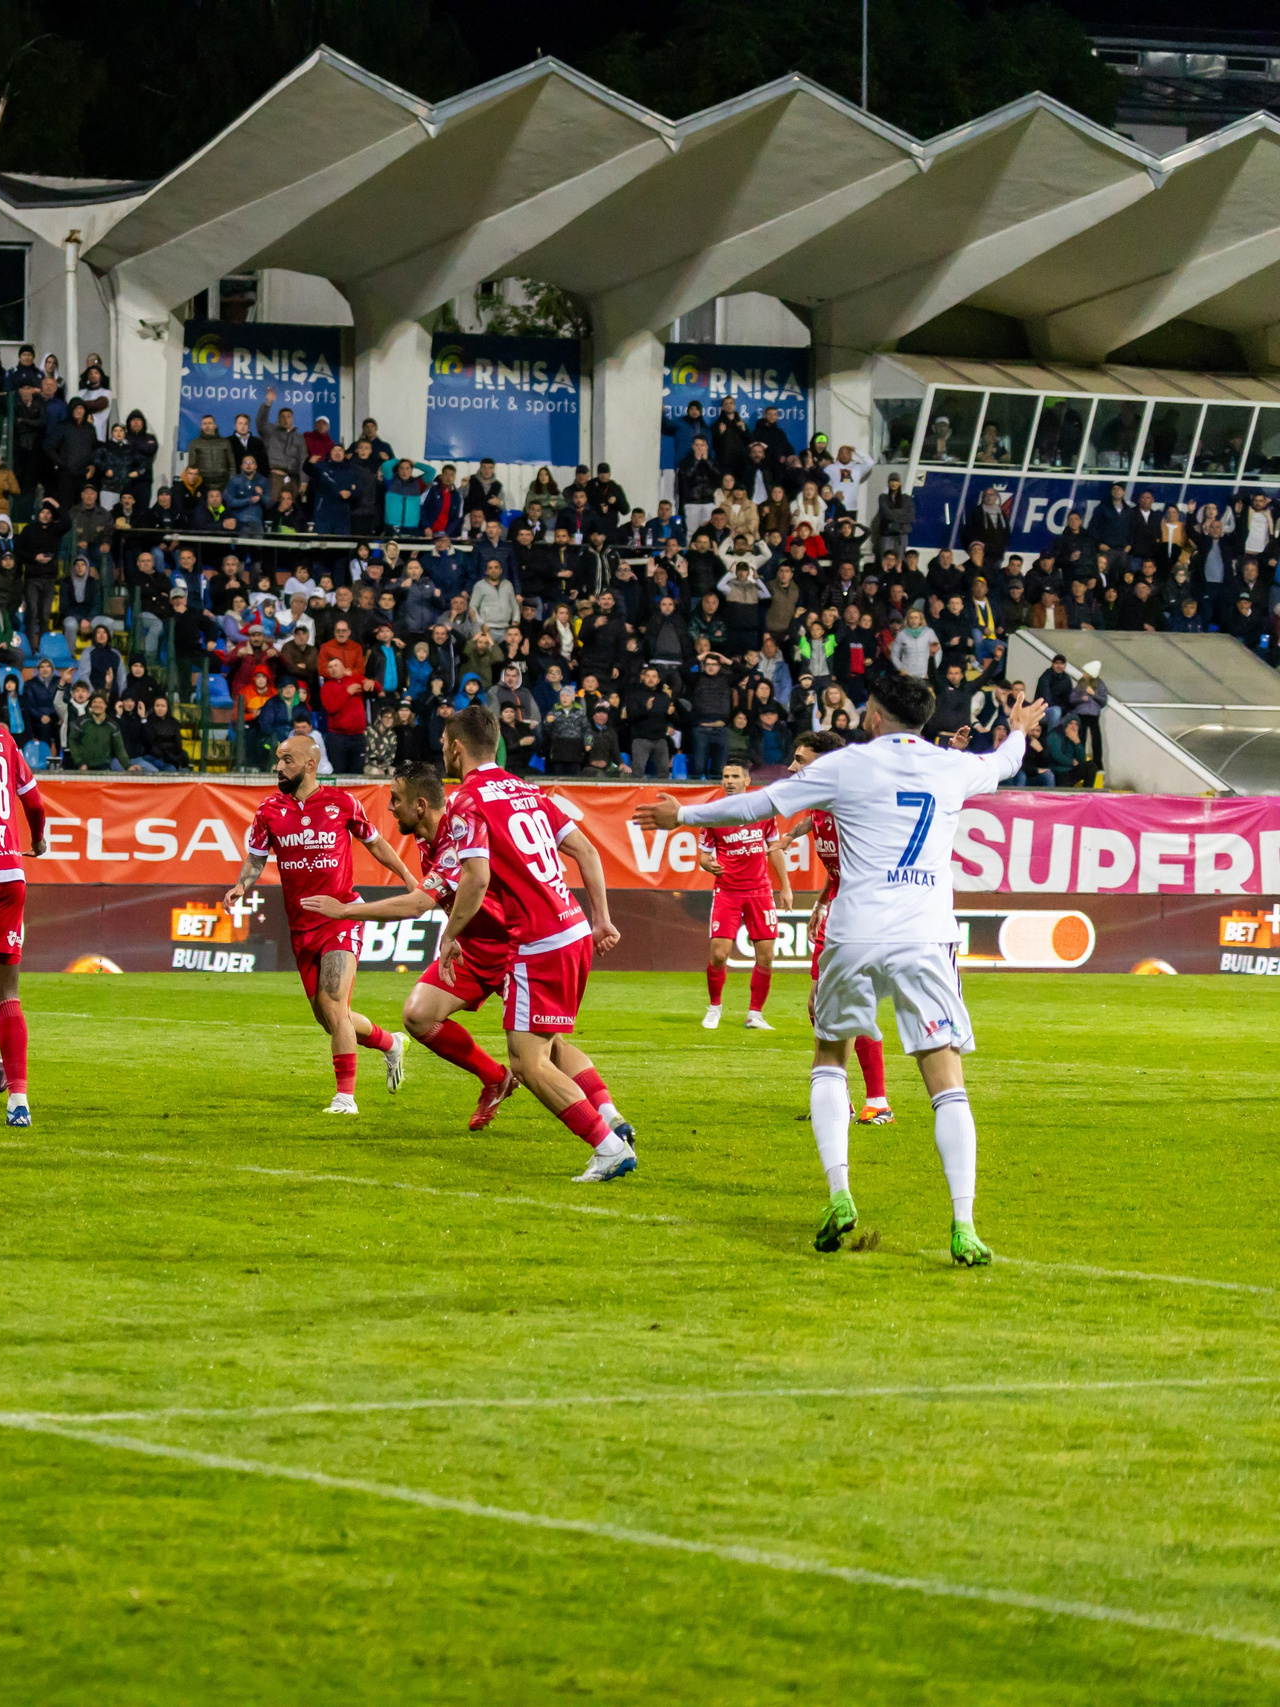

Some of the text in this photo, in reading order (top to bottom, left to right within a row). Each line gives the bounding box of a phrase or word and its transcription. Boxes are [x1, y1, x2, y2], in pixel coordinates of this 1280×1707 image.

[284, 388, 337, 405] sports
[507, 396, 519, 411] &
[525, 398, 577, 415] sports
[756, 406, 805, 421] sorts
[276, 828, 337, 848] WIN2.RO
[896, 791, 936, 869] 7
[887, 868, 936, 887] MAILAT
[177, 914, 218, 937] BET
[763, 909, 777, 926] 18
[1223, 921, 1259, 943] BET
[172, 948, 257, 973] BUILDER
[1220, 953, 1280, 976] BUILDE
